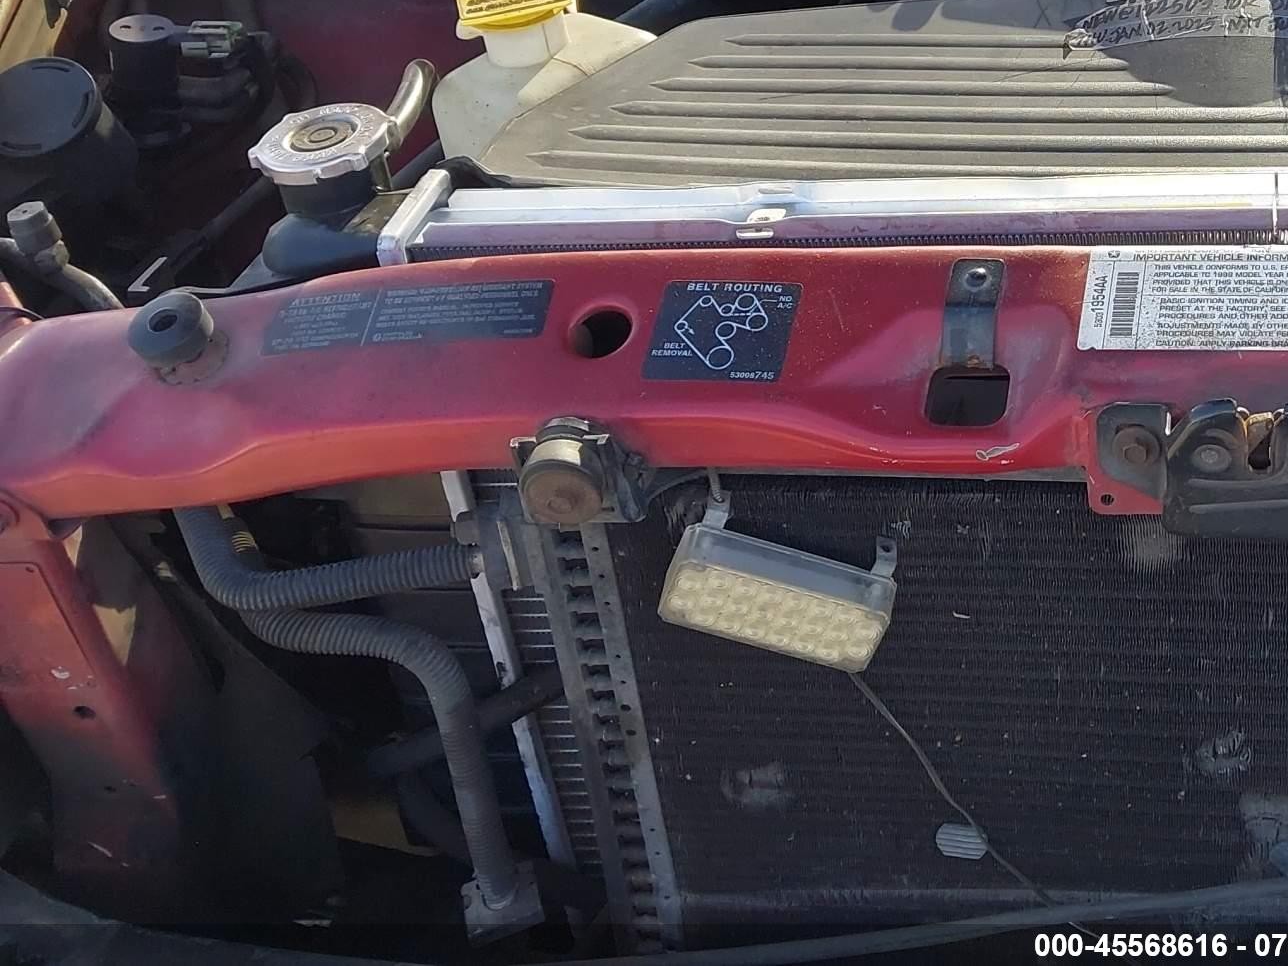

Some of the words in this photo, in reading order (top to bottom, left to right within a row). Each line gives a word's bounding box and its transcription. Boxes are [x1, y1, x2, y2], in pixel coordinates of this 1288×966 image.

[1132, 253, 1197, 262] IMPORTANT
[1200, 253, 1245, 262] VEHICLE
[686, 282, 719, 292] BELT
[723, 283, 783, 293] ROUTING
[778, 295, 793, 303] NO
[1160, 297, 1187, 305] BASIC
[1187, 297, 1225, 305] IGNITION
[1228, 297, 1258, 305] TIMING
[1260, 297, 1279, 305] AND
[1158, 312, 1216, 320] PROCEDURES
[1218, 312, 1238, 320] AND
[1239, 312, 1268, 320] OTHER
[1157, 322, 1222, 330] ADJUSTMENTS
[1223, 322, 1250, 330] MADE
[1251, 322, 1264, 330] BY
[1156, 330, 1214, 338] PROCEDURES
[1216, 330, 1237, 338] MAY
[1238, 330, 1275, 338] VIOLATE
[1198, 340, 1227, 348] APPLY
[1229, 340, 1269, 348] PARKING
[651, 349, 693, 357] REMOVAL
[729, 371, 775, 380] 53008745
